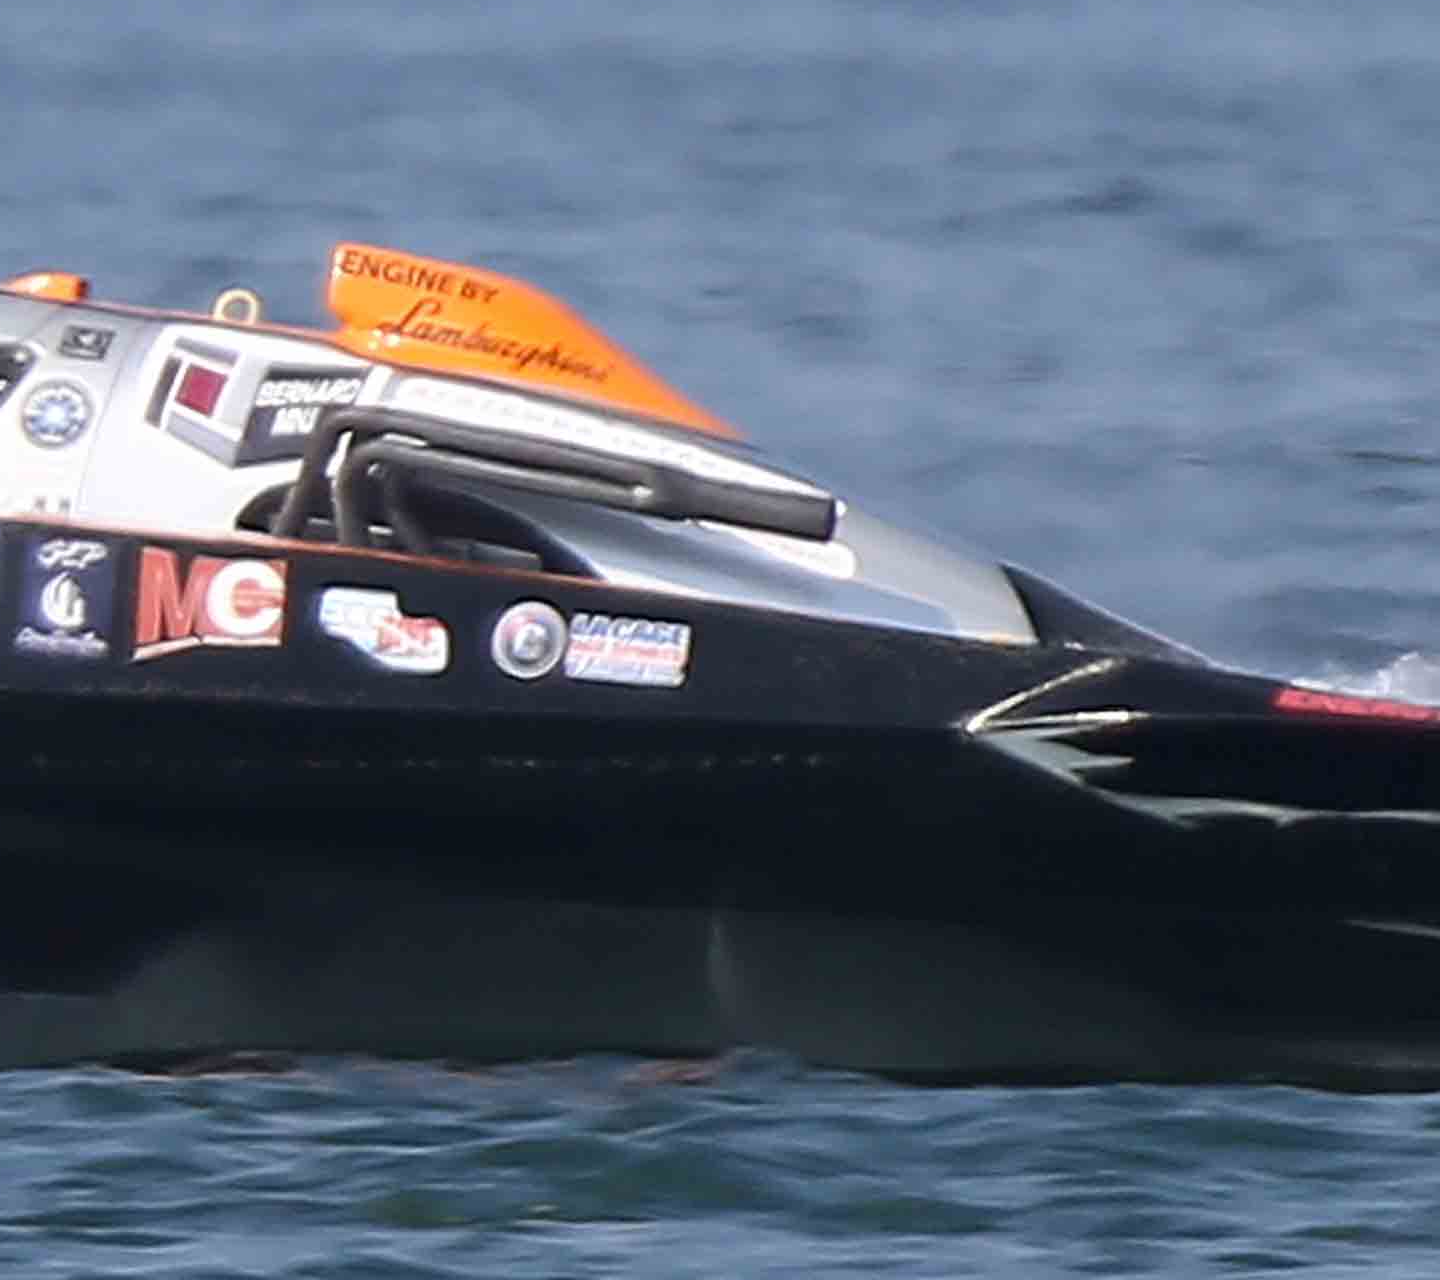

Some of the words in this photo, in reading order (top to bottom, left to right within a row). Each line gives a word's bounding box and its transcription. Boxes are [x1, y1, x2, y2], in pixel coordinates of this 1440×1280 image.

[340, 249, 450, 297] ENGINE
[459, 278, 500, 304] BY
[377, 297, 610, 384] Lamborghini
